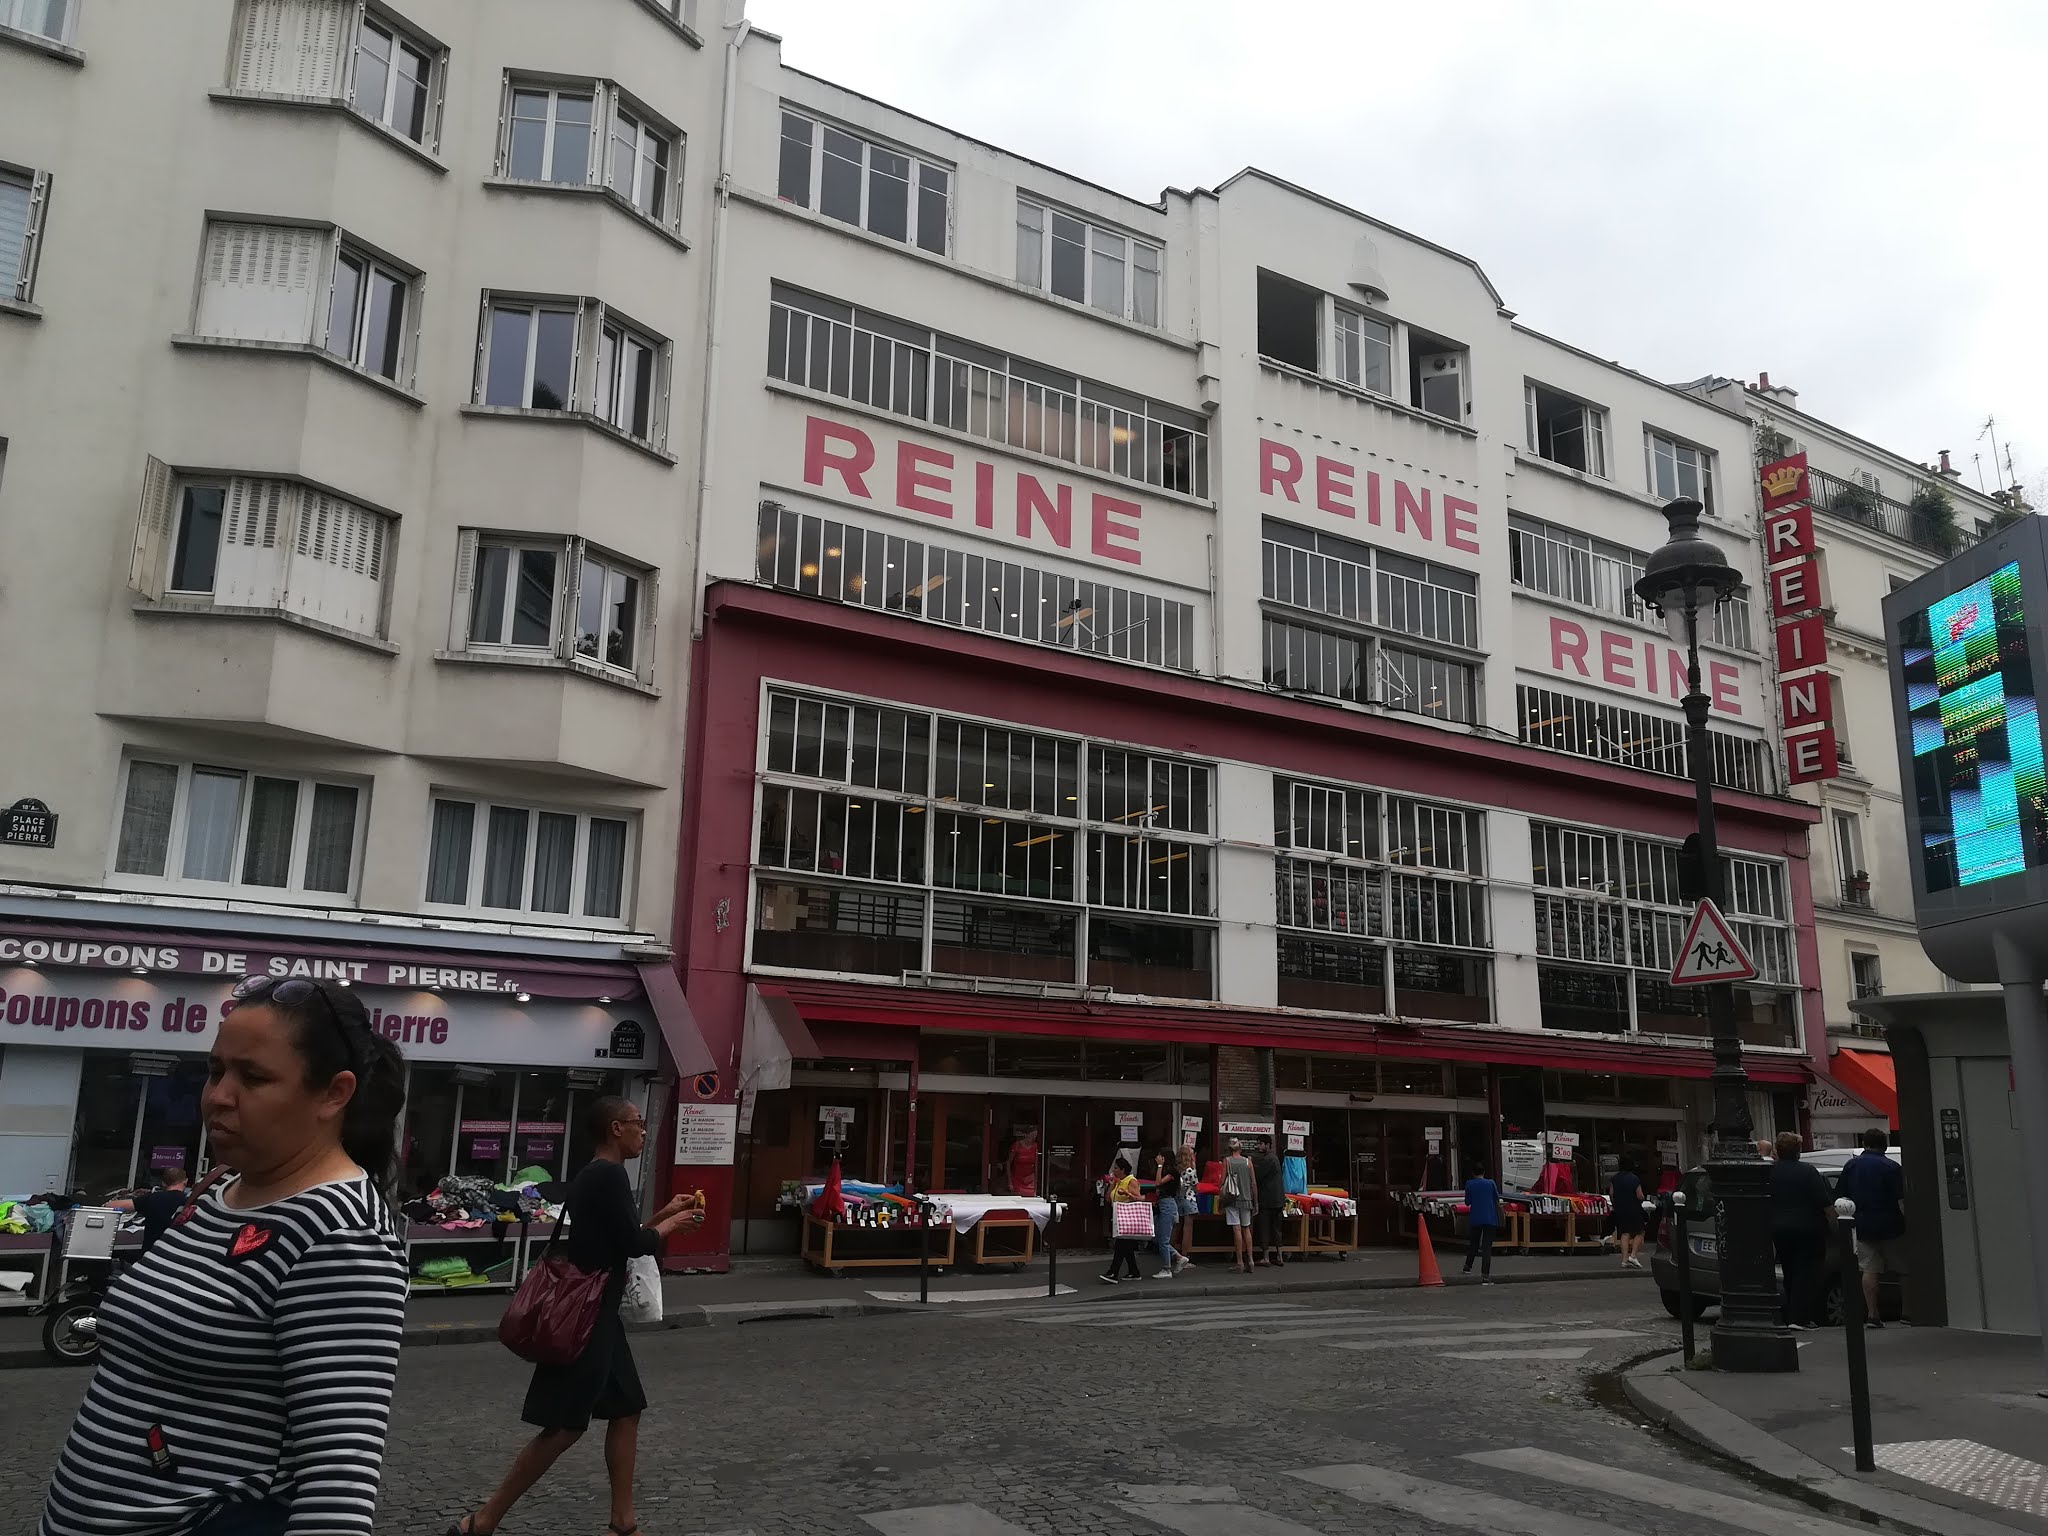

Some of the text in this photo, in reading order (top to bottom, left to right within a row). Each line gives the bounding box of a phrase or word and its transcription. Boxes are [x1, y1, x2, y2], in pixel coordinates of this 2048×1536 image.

[804, 415, 1142, 565] REINE
[1260, 437, 1480, 554] REINE
[1772, 518, 1823, 774] REINE
[1549, 616, 1742, 715] REINE
[12, 815, 46, 826] PLACE
[12, 823, 45, 834] SAINT
[6, 831, 47, 842] PIERRE
[0, 938, 180, 970] COUPONS
[202, 951, 248, 973] DE
[268, 956, 369, 981] SAINT
[162, 998, 208, 1034] de
[365, 1008, 449, 1045] ierre
[1814, 1089, 1847, 1111] Reine
[683, 1105, 705, 1117] Reine
[682, 1117, 690, 1125] 3
[681, 1127, 689, 1135] 2
[1553, 1132, 1574, 1143] Reine
[151, 1152, 158, 1160] 3
